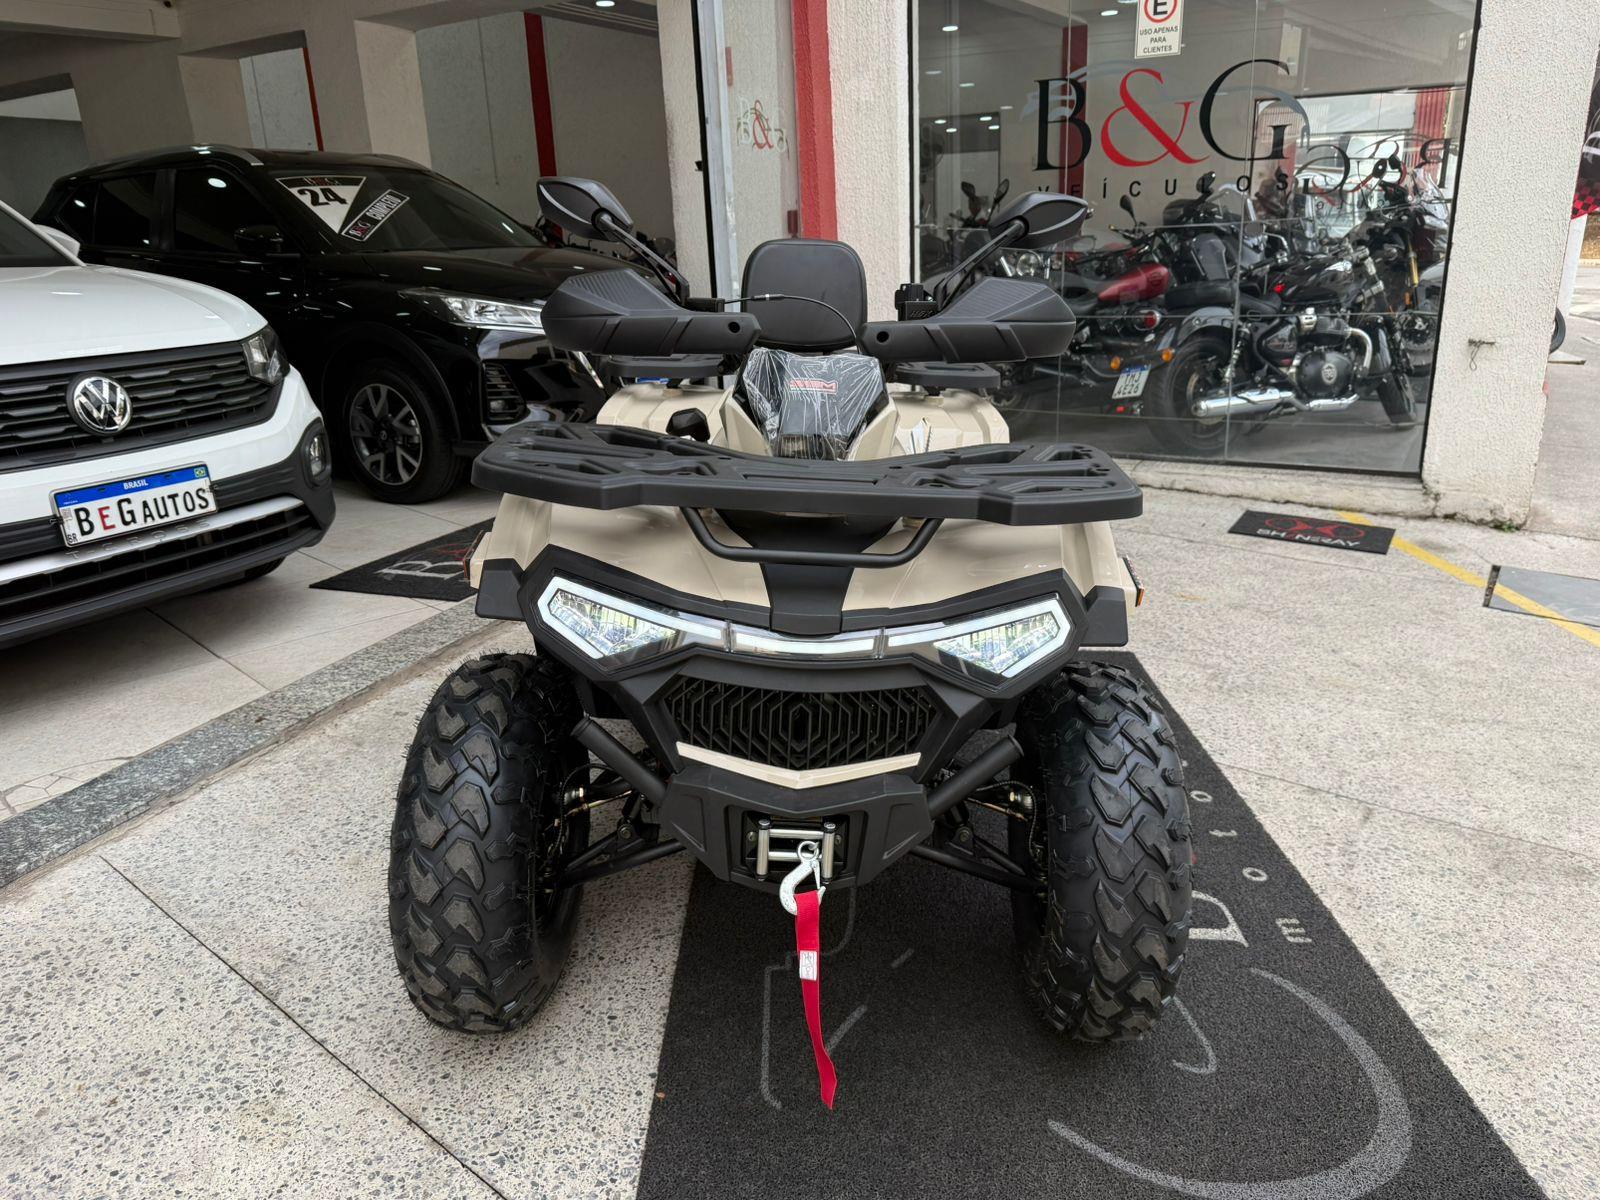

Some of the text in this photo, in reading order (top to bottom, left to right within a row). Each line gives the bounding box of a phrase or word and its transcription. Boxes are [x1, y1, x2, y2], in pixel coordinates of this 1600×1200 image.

[1140, 25, 1179, 36] USO APENAS
[1150, 36, 1167, 44] PARA
[1143, 45, 1173, 54] CLIENTES
[1032, 58, 1293, 171] B&G
[296, 187, 348, 207] 24
[123, 479, 150, 491] BRASIL
